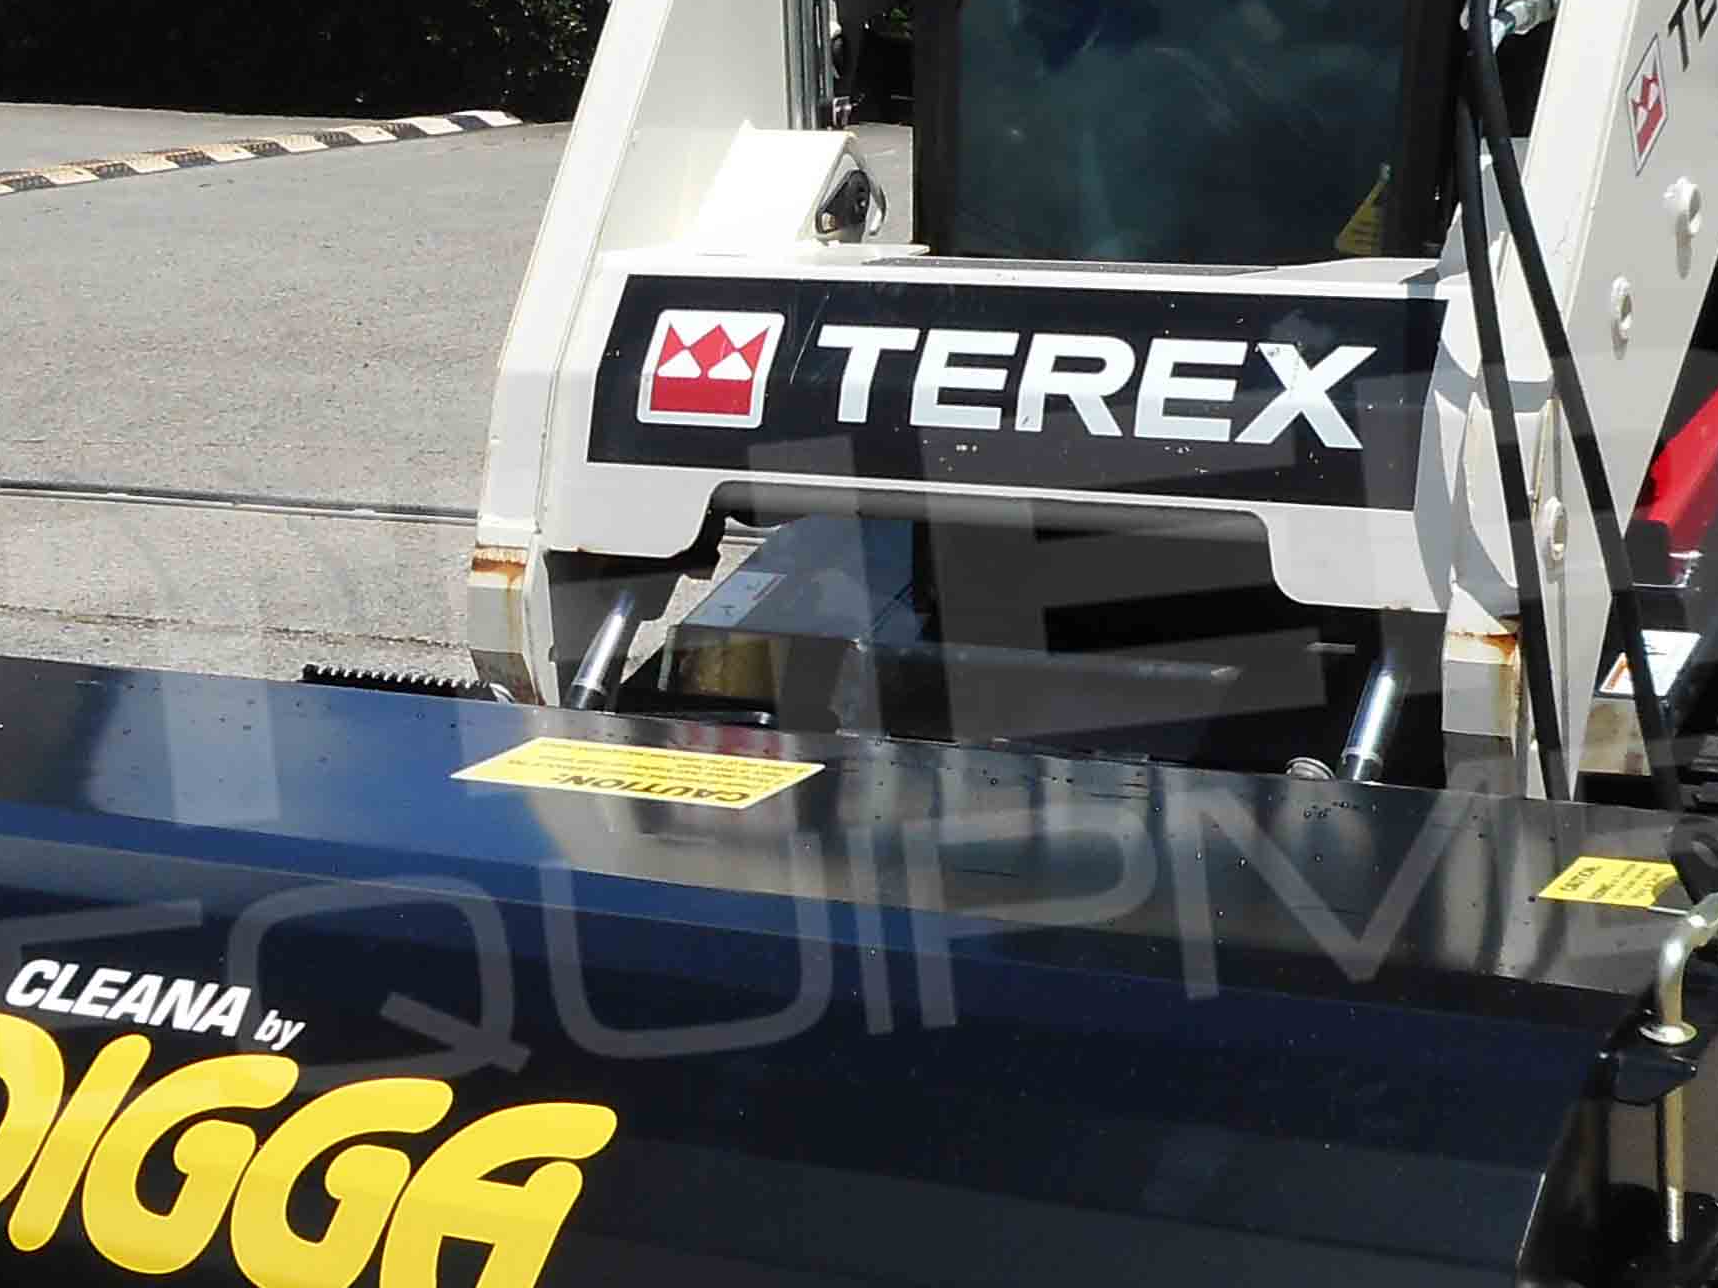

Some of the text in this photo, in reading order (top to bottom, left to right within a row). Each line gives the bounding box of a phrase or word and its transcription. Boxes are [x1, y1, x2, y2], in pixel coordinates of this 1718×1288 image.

[815, 323, 1377, 450] TEREX
[4, 959, 306, 1049] CLEANA by
